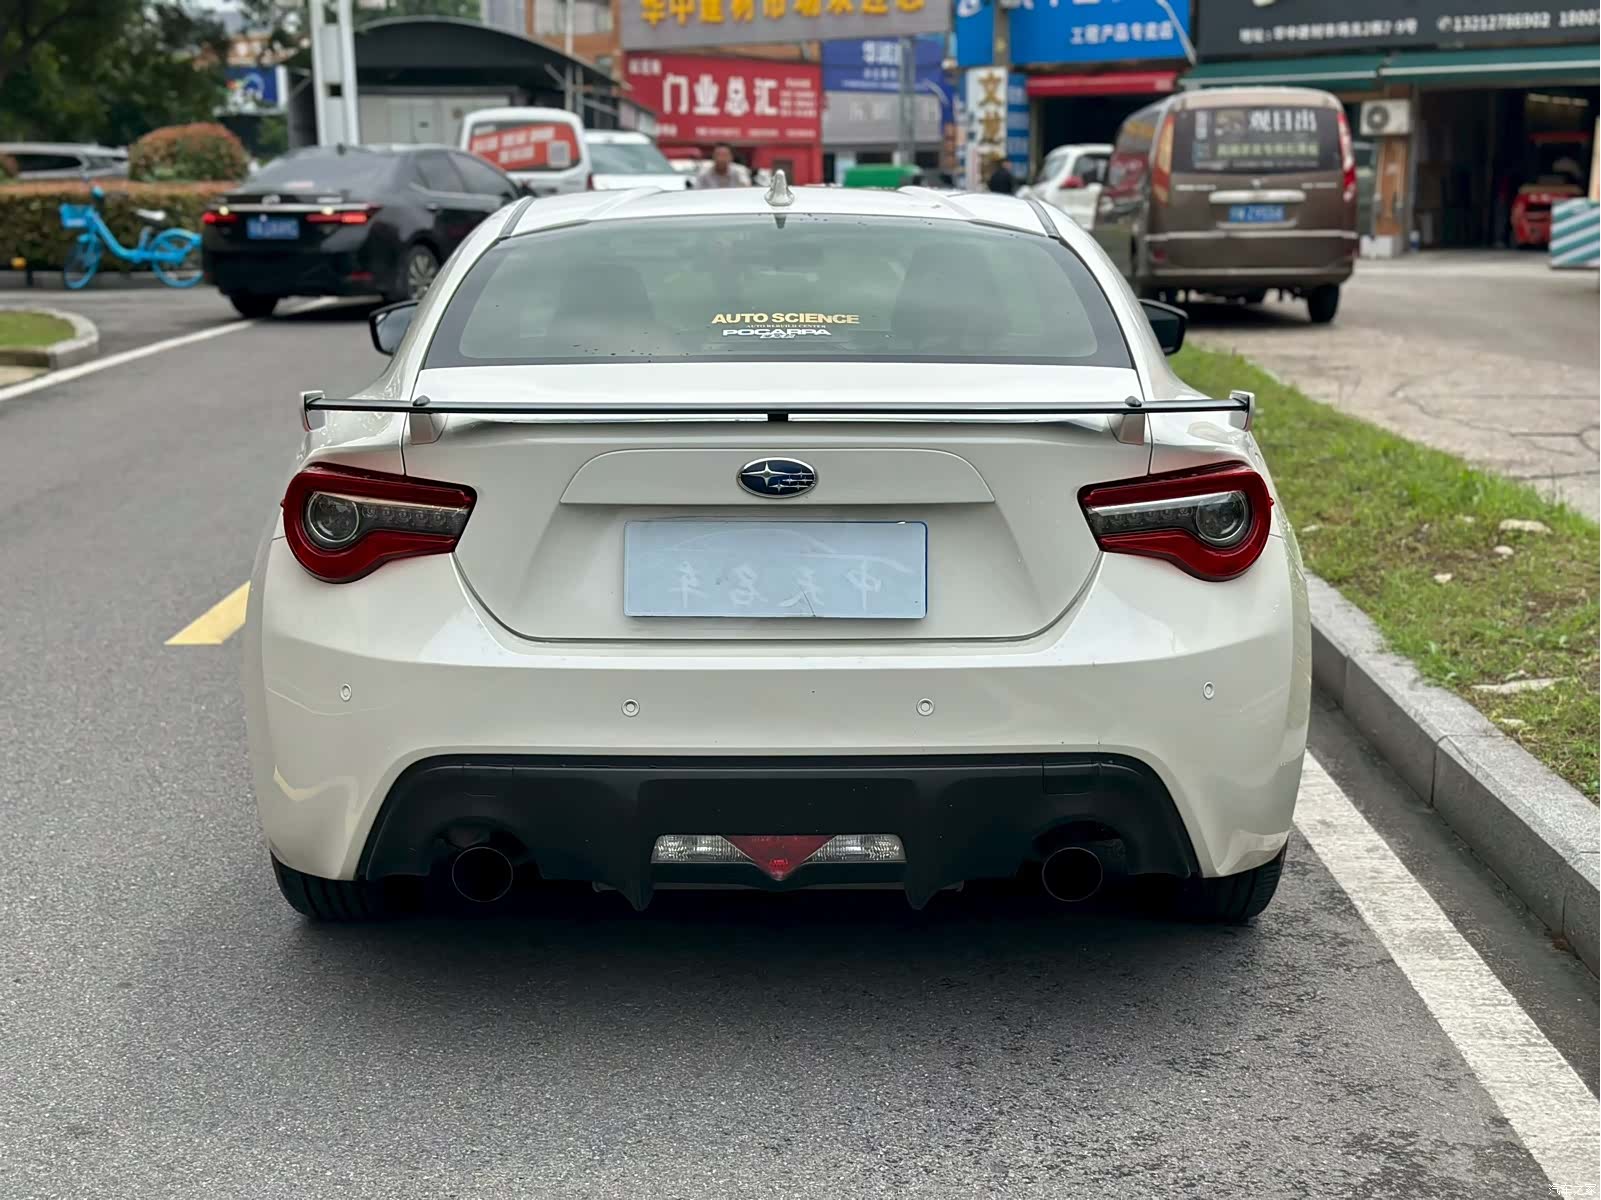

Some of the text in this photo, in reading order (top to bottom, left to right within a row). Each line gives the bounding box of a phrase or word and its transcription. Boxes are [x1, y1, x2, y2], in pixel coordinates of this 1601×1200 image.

[661, 72, 779, 117] 门业总汇
[711, 312, 861, 325] AUTO SCIENCE
